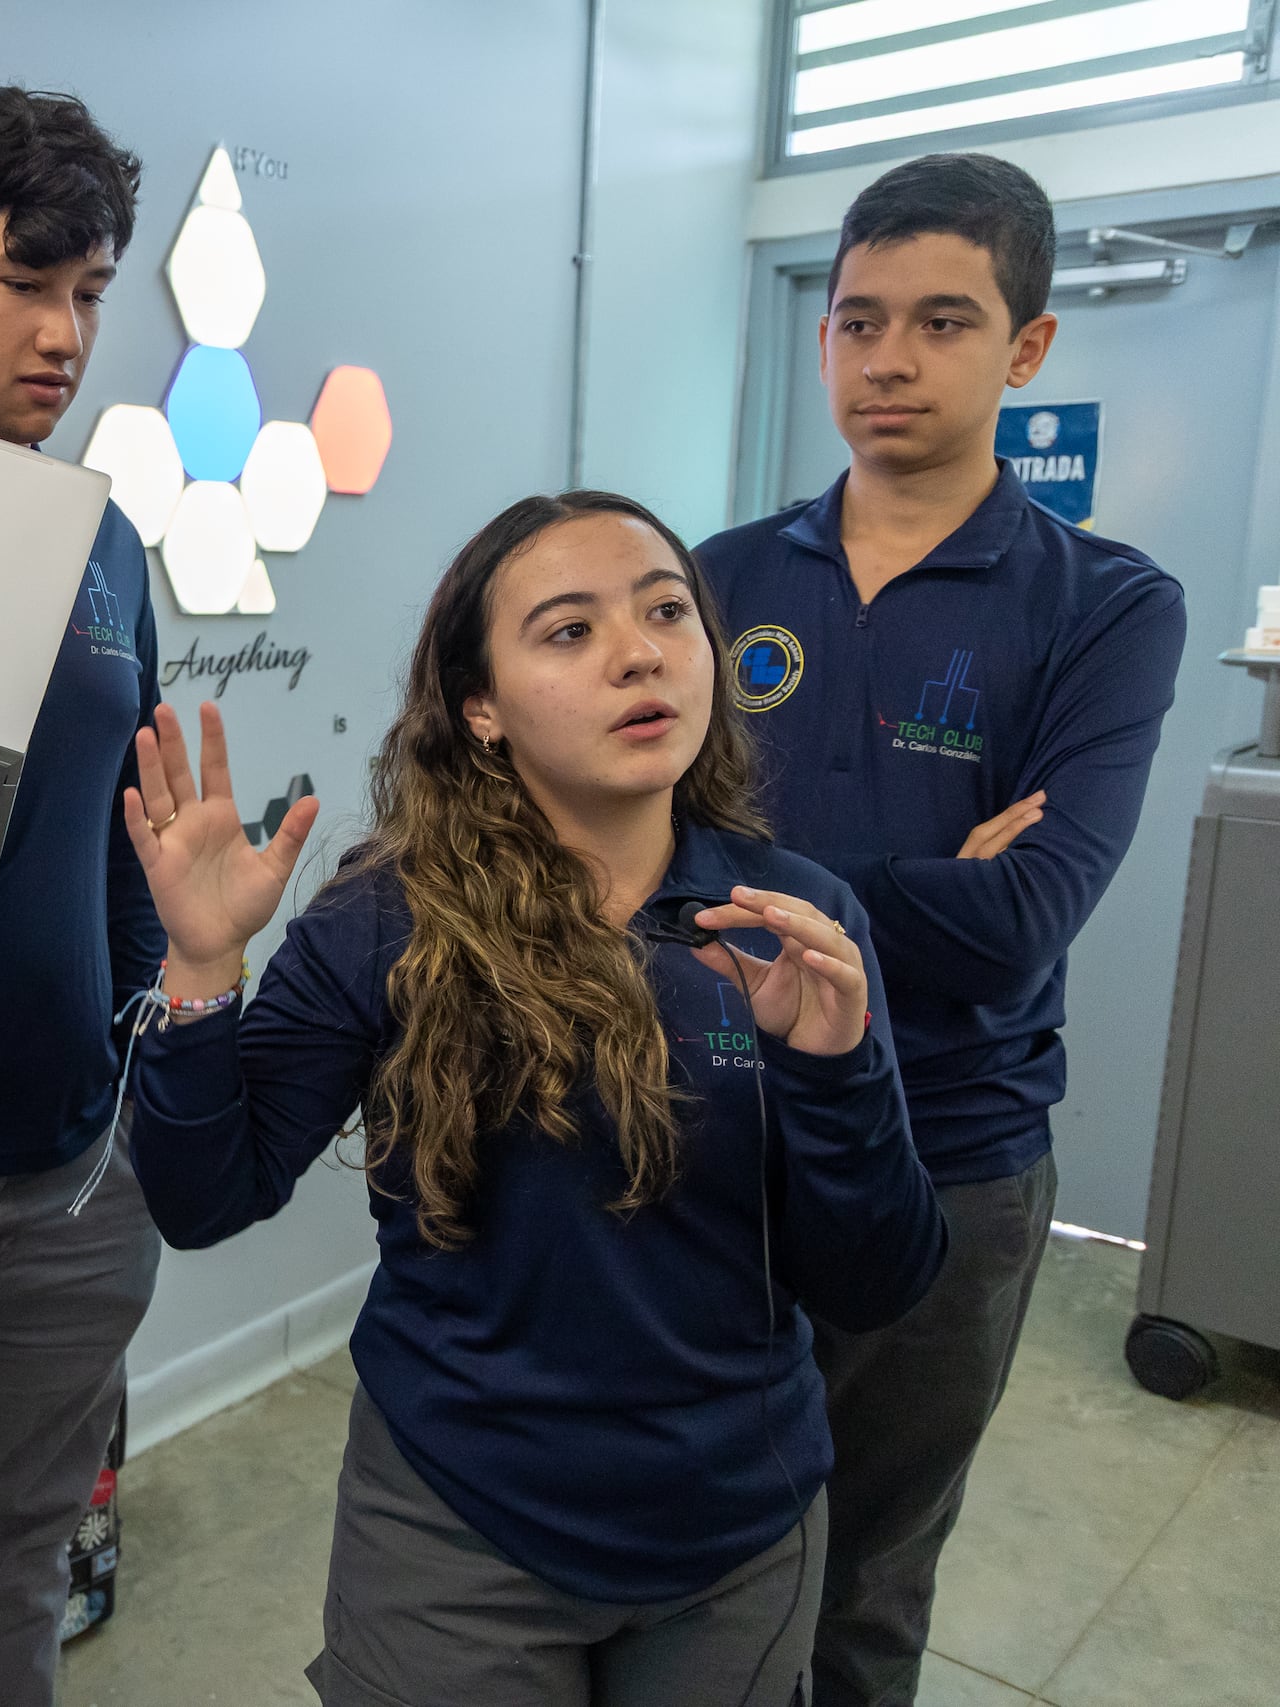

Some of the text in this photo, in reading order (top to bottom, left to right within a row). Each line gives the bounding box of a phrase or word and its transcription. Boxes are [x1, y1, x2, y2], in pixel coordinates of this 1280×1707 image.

[1009, 454, 1085, 482] NTRADA
[87, 625, 114, 641] TECH
[160, 630, 312, 698] Anything
[333, 714, 347, 734] is
[898, 721, 983, 751] TECH CLUB
[892, 738, 906, 749] Dr.
[908, 741, 937, 754] Carlos
[703, 1032, 753, 1051] TECH
[733, 1056, 766, 1070] Caro
